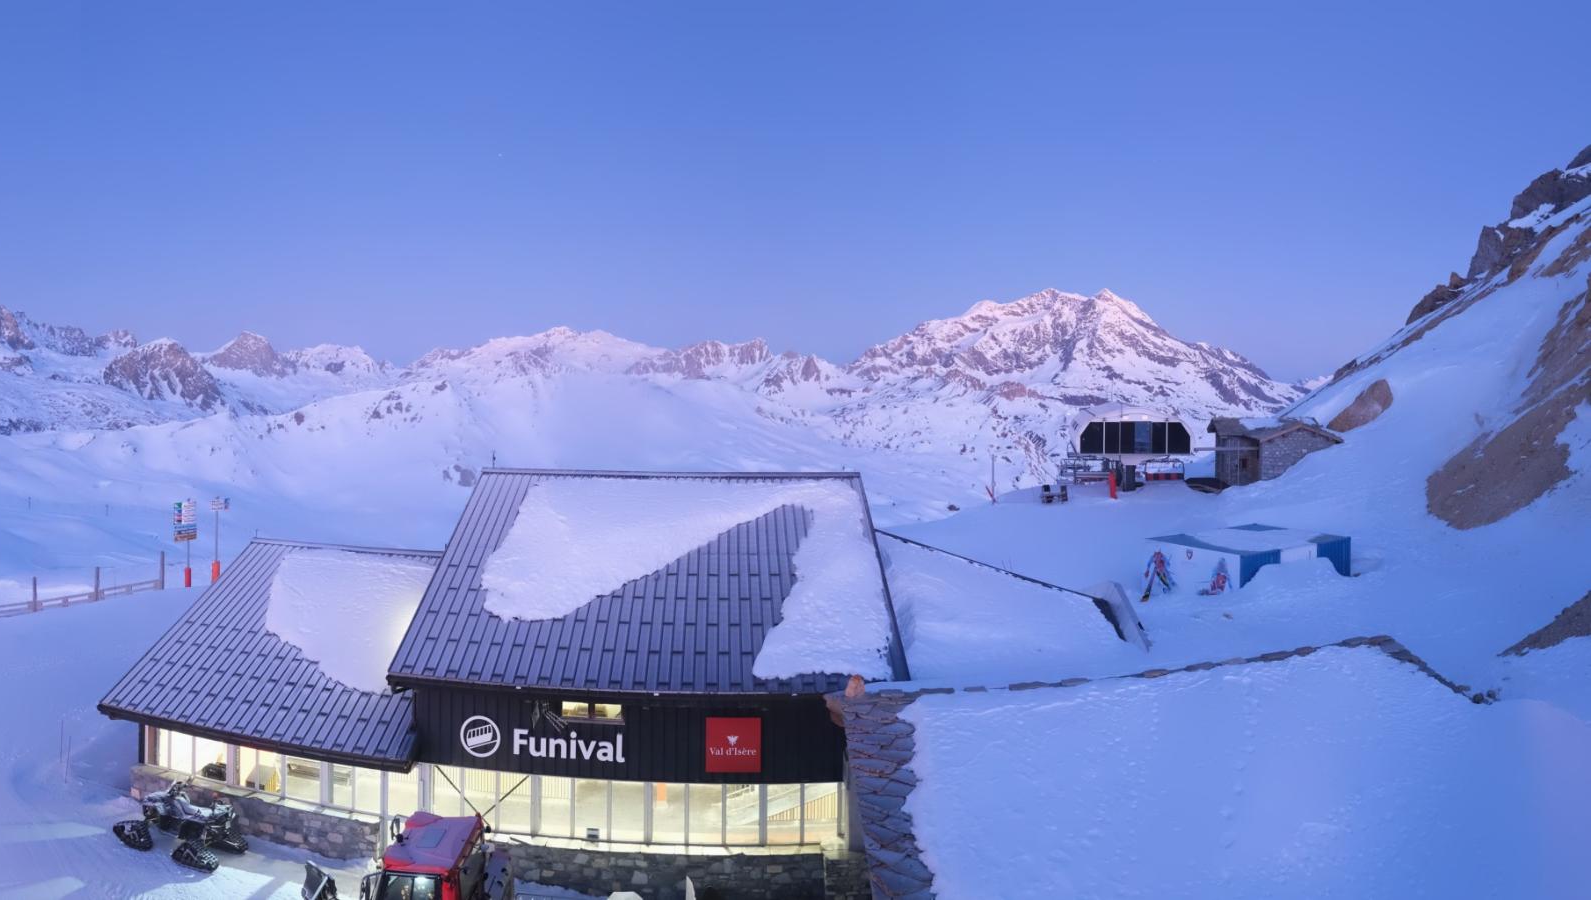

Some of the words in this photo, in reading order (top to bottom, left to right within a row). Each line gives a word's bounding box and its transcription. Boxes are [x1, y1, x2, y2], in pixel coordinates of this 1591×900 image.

[513, 728, 626, 763] Funival
[709, 747, 724, 756] Val
[726, 747, 756, 756] d'Isère
